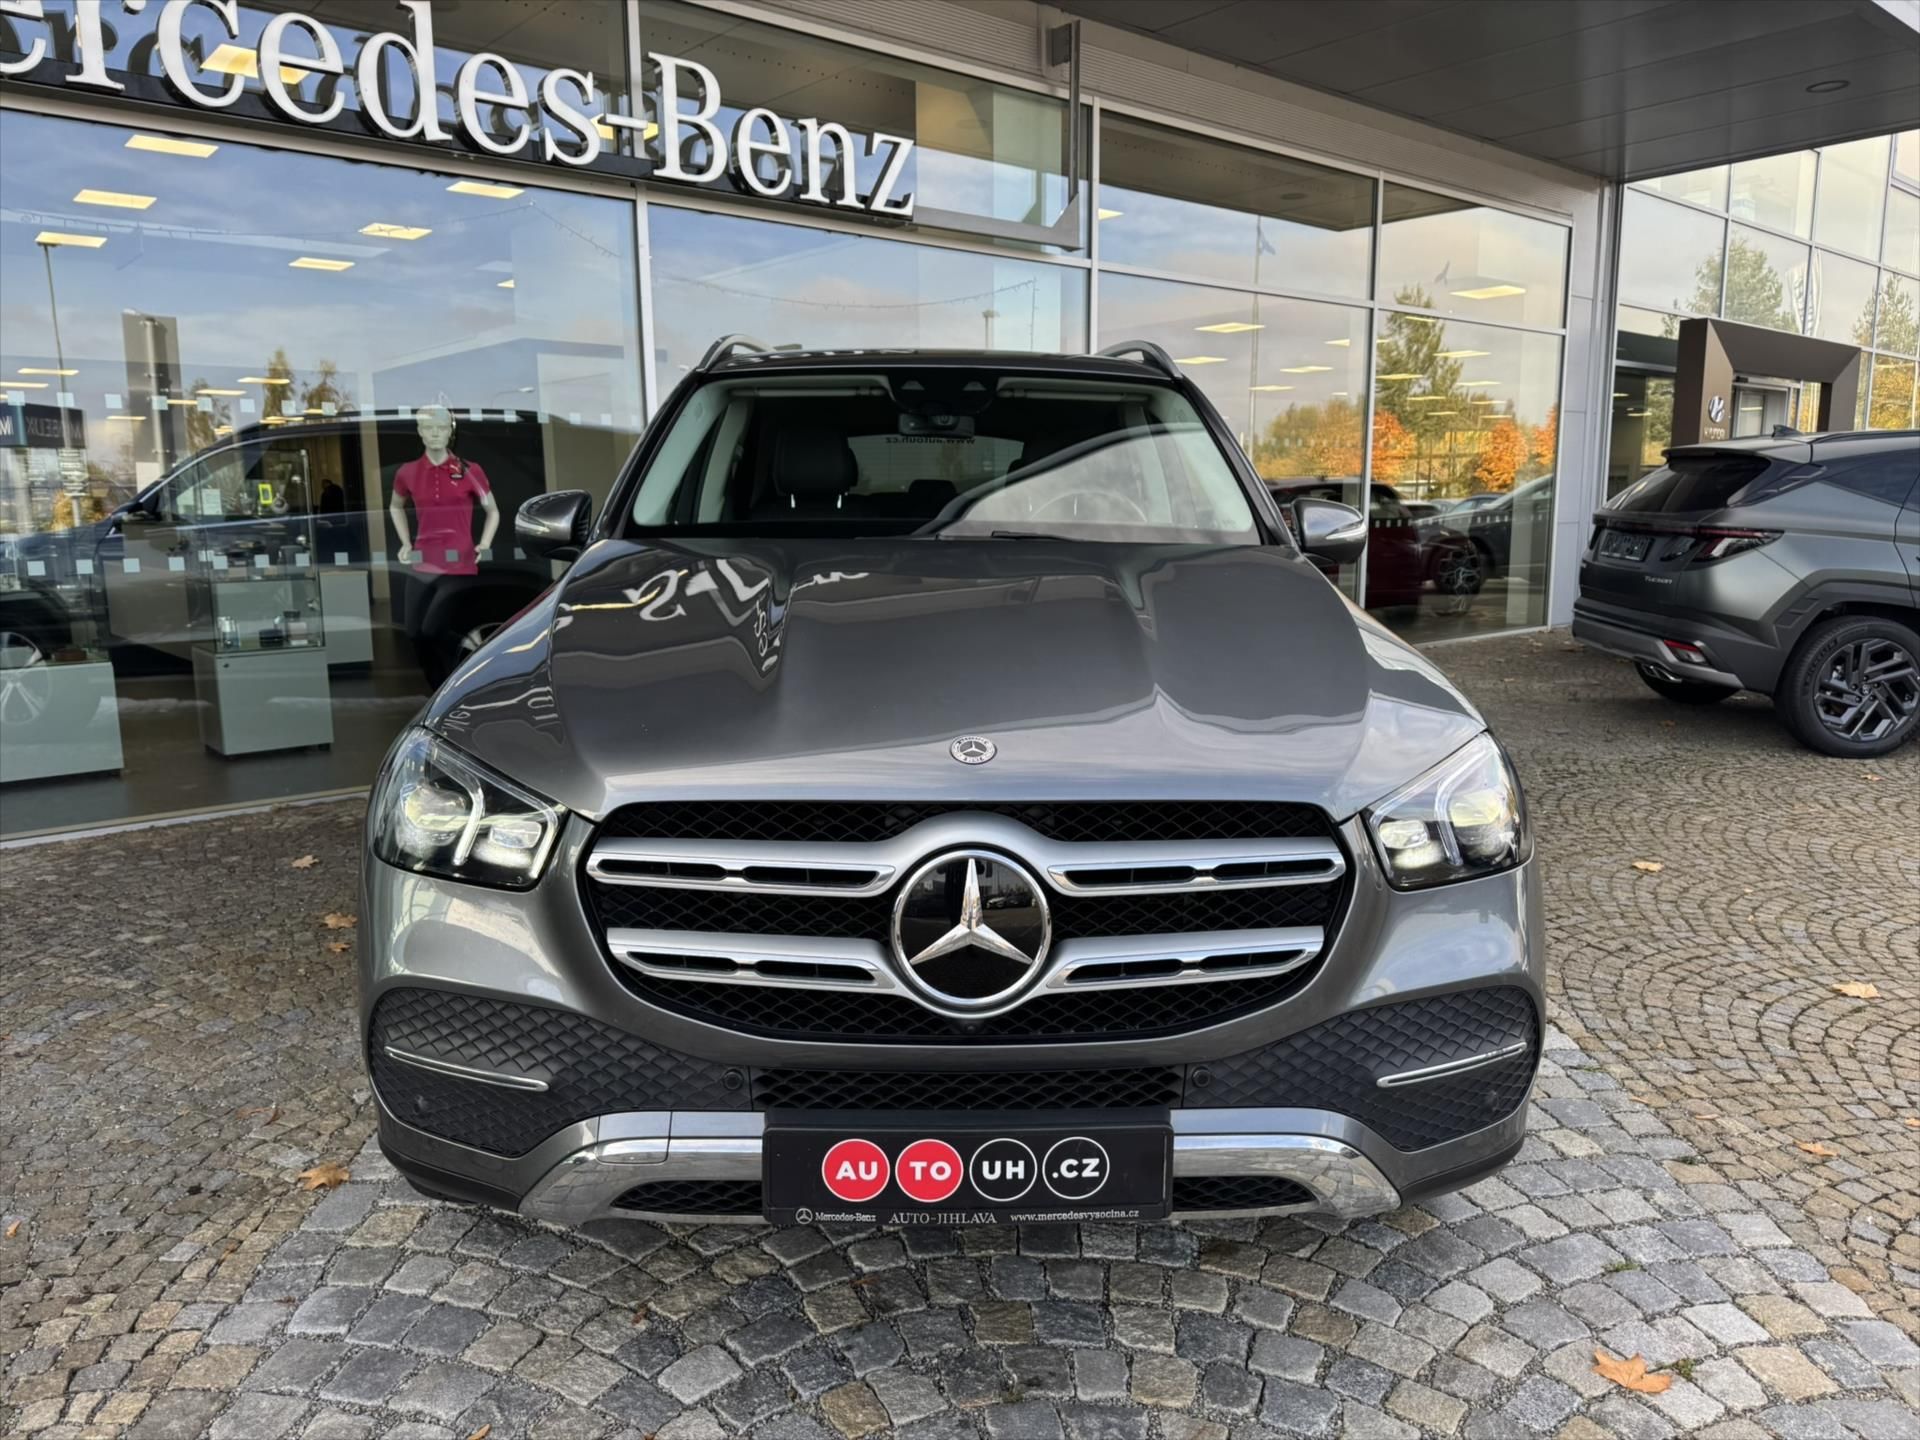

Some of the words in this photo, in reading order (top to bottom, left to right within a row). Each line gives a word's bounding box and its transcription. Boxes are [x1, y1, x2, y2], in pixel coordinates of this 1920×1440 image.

[835, 1160, 878, 1180] AU
[909, 1160, 952, 1181] TO
[982, 1159, 1025, 1180] UH
[1052, 1158, 1100, 1179] .CZ
[815, 1211, 877, 1222] Mercedes-Benz
[889, 1212, 998, 1224] AUTO-JIHLAVA
[1010, 1208, 1140, 1223] www.mercedesvysocina.cz
